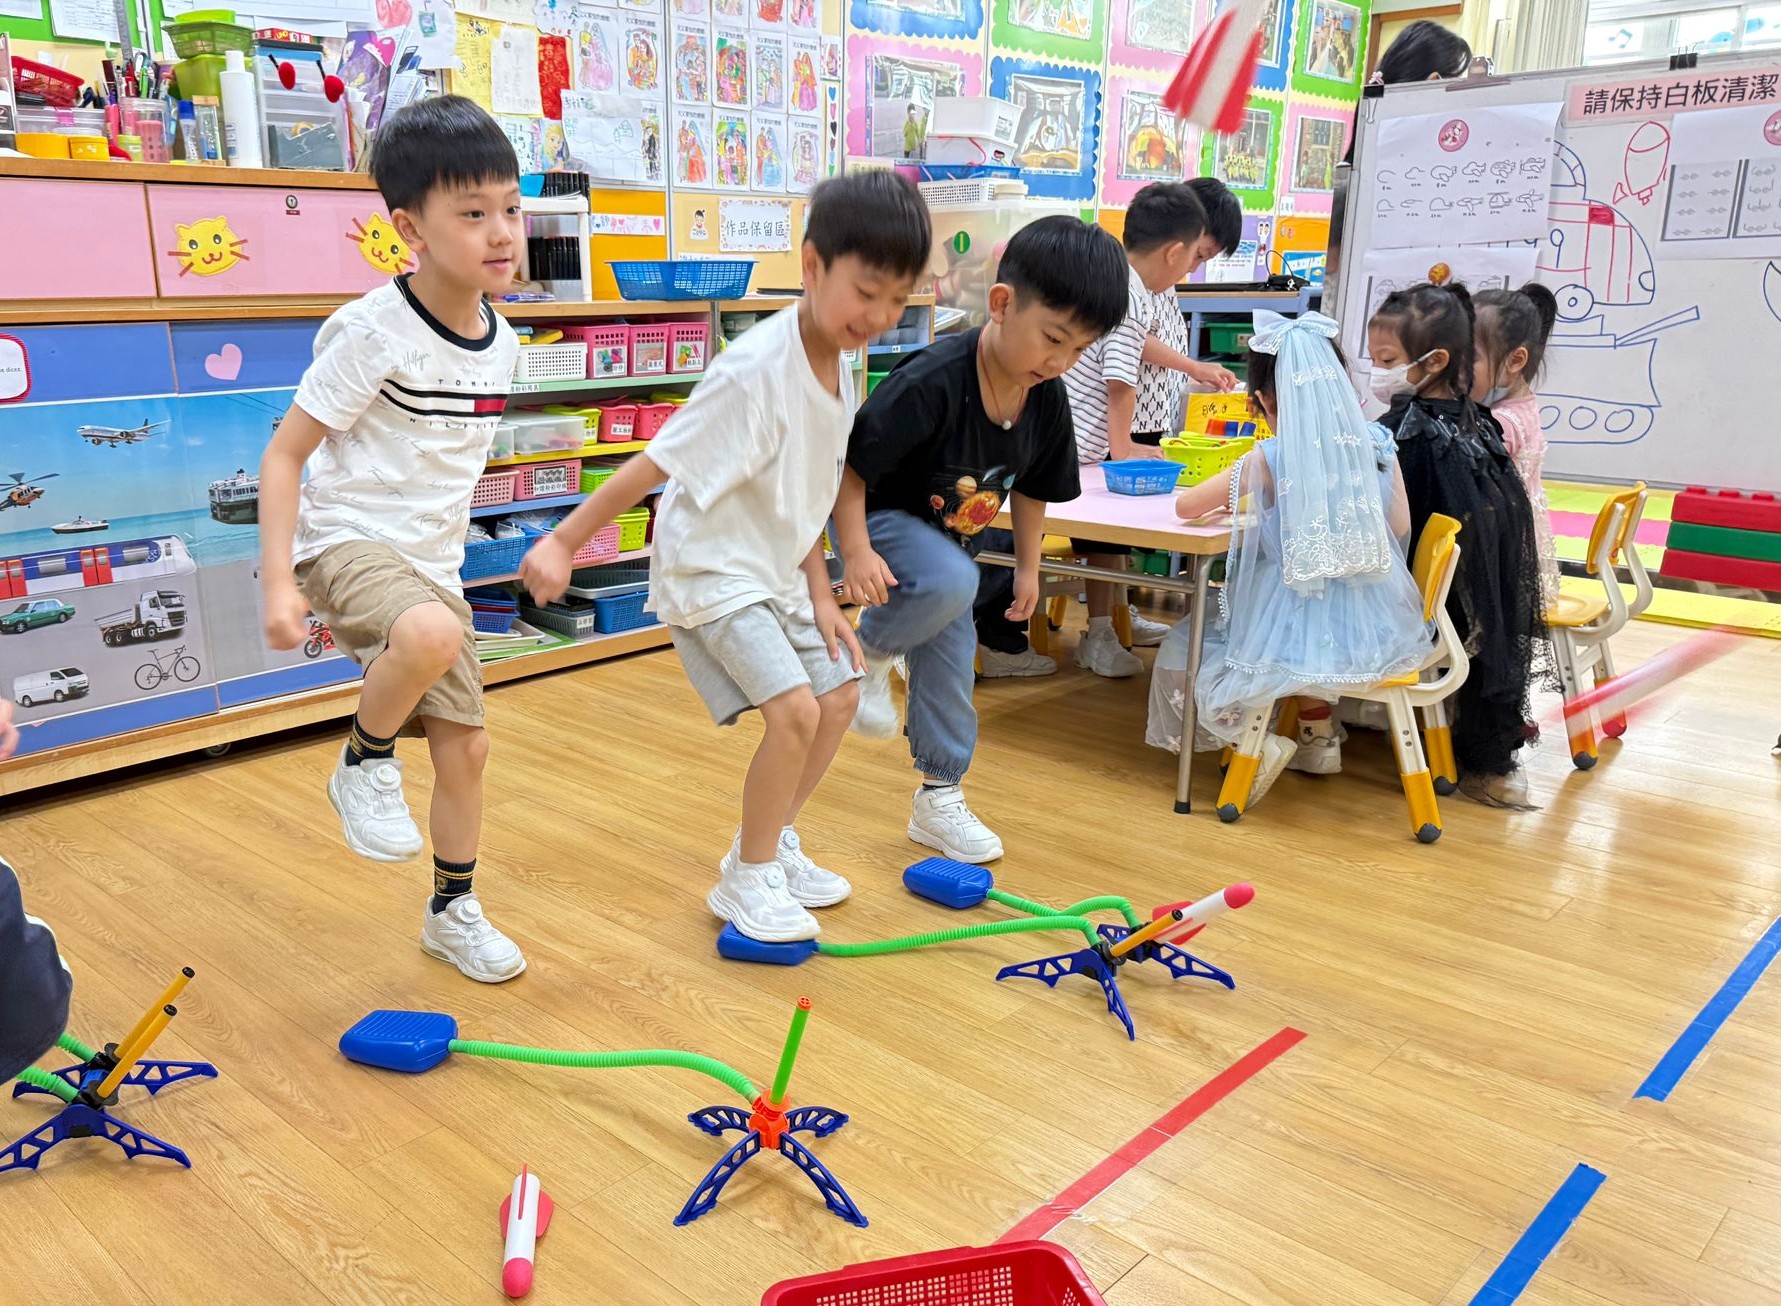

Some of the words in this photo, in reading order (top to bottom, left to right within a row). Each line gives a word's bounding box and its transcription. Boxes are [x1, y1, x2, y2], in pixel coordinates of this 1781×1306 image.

[1583, 73, 1779, 115] 請保持白板清潔
[725, 220, 787, 237] 作品保留區
